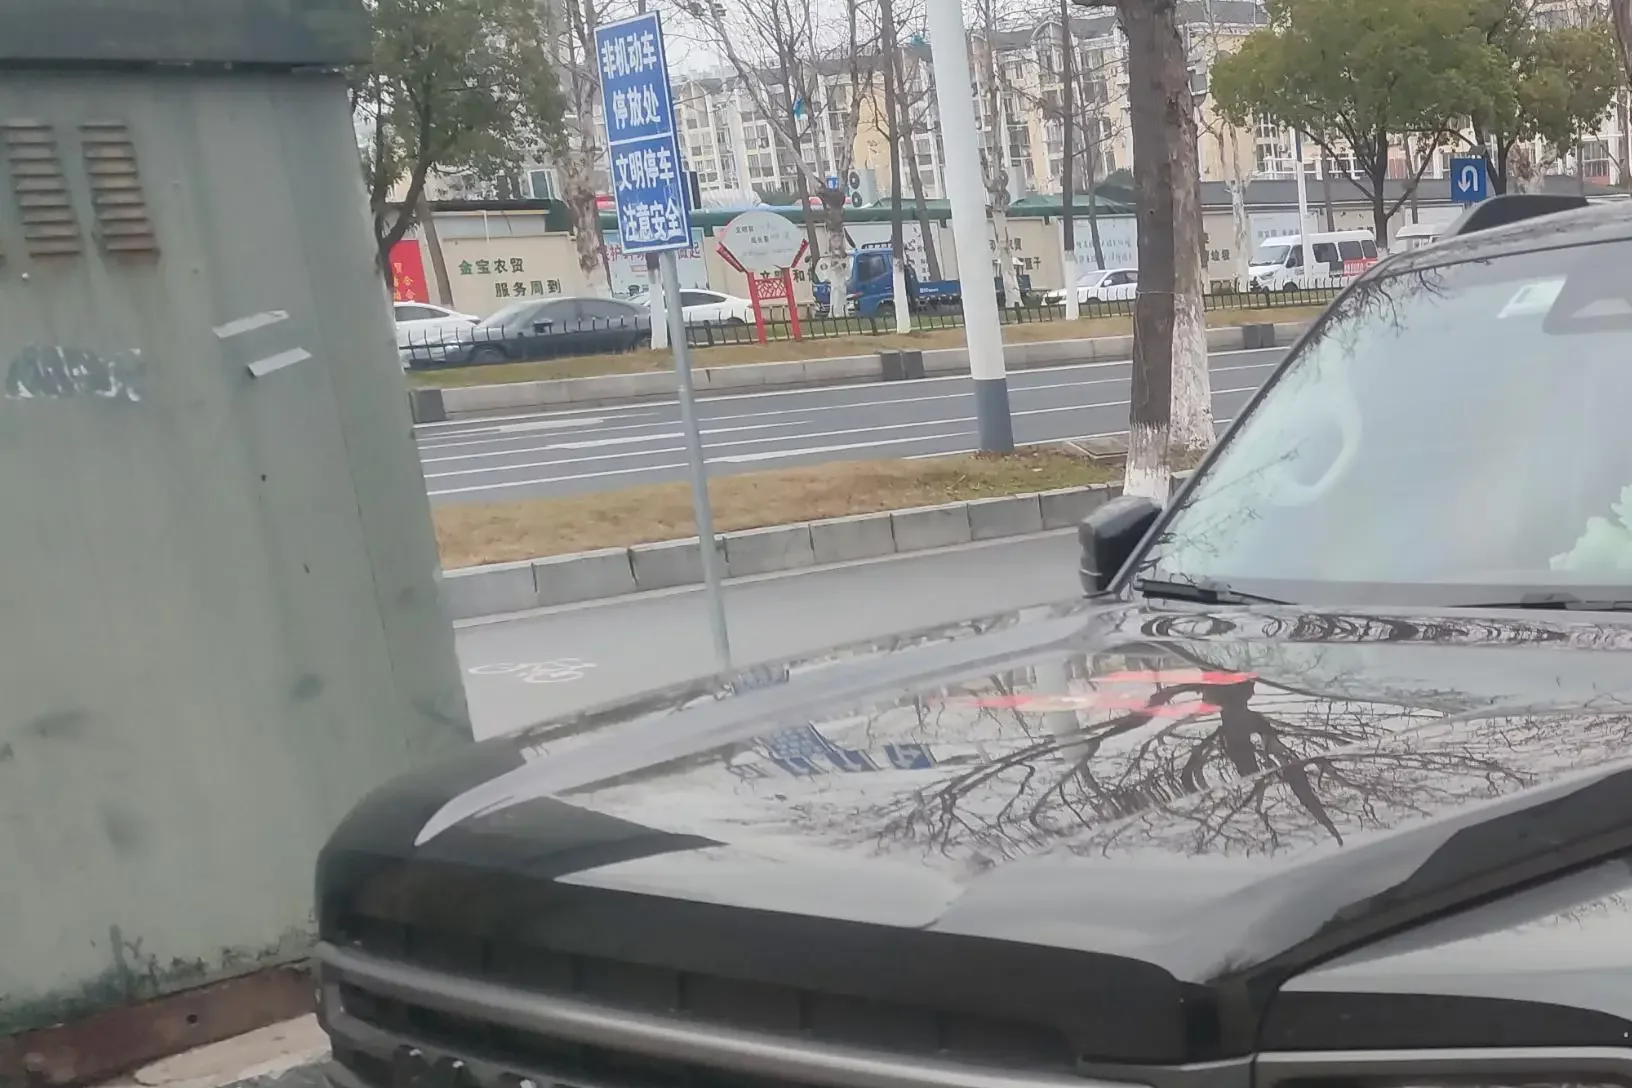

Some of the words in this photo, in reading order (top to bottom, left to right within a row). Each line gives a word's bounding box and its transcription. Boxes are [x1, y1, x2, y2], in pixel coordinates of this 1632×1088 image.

[601, 30, 657, 79] 非机动车
[613, 83, 661, 130] 停放处
[616, 146, 675, 191] 文明停车
[623, 197, 683, 241] 注意安全
[459, 258, 524, 275] 金宝农贸
[495, 278, 561, 297] 服务周到
